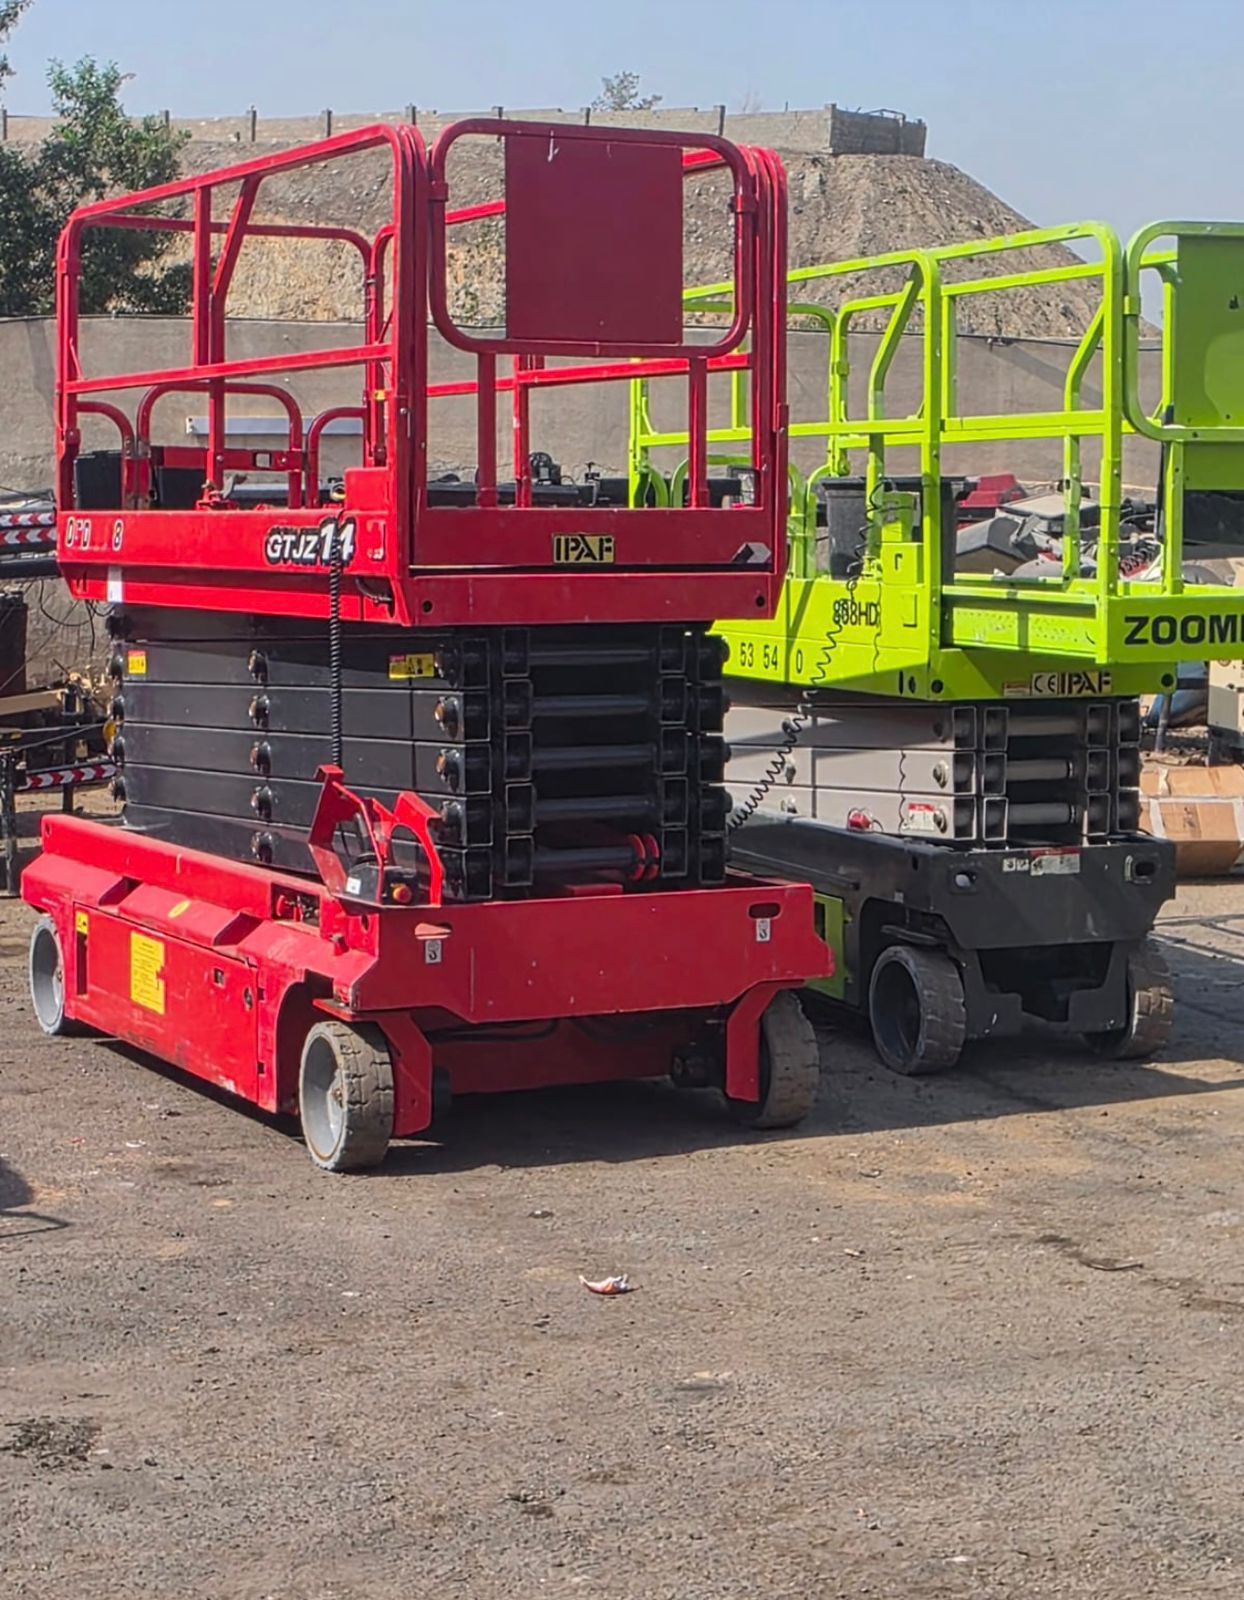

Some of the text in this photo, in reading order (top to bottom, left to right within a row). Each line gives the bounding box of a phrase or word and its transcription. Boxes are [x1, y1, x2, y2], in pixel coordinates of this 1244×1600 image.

[555, 534, 613, 562] IPAF
[1124, 614, 1244, 645] ZOOM
[1060, 671, 1112, 695] IPAF
